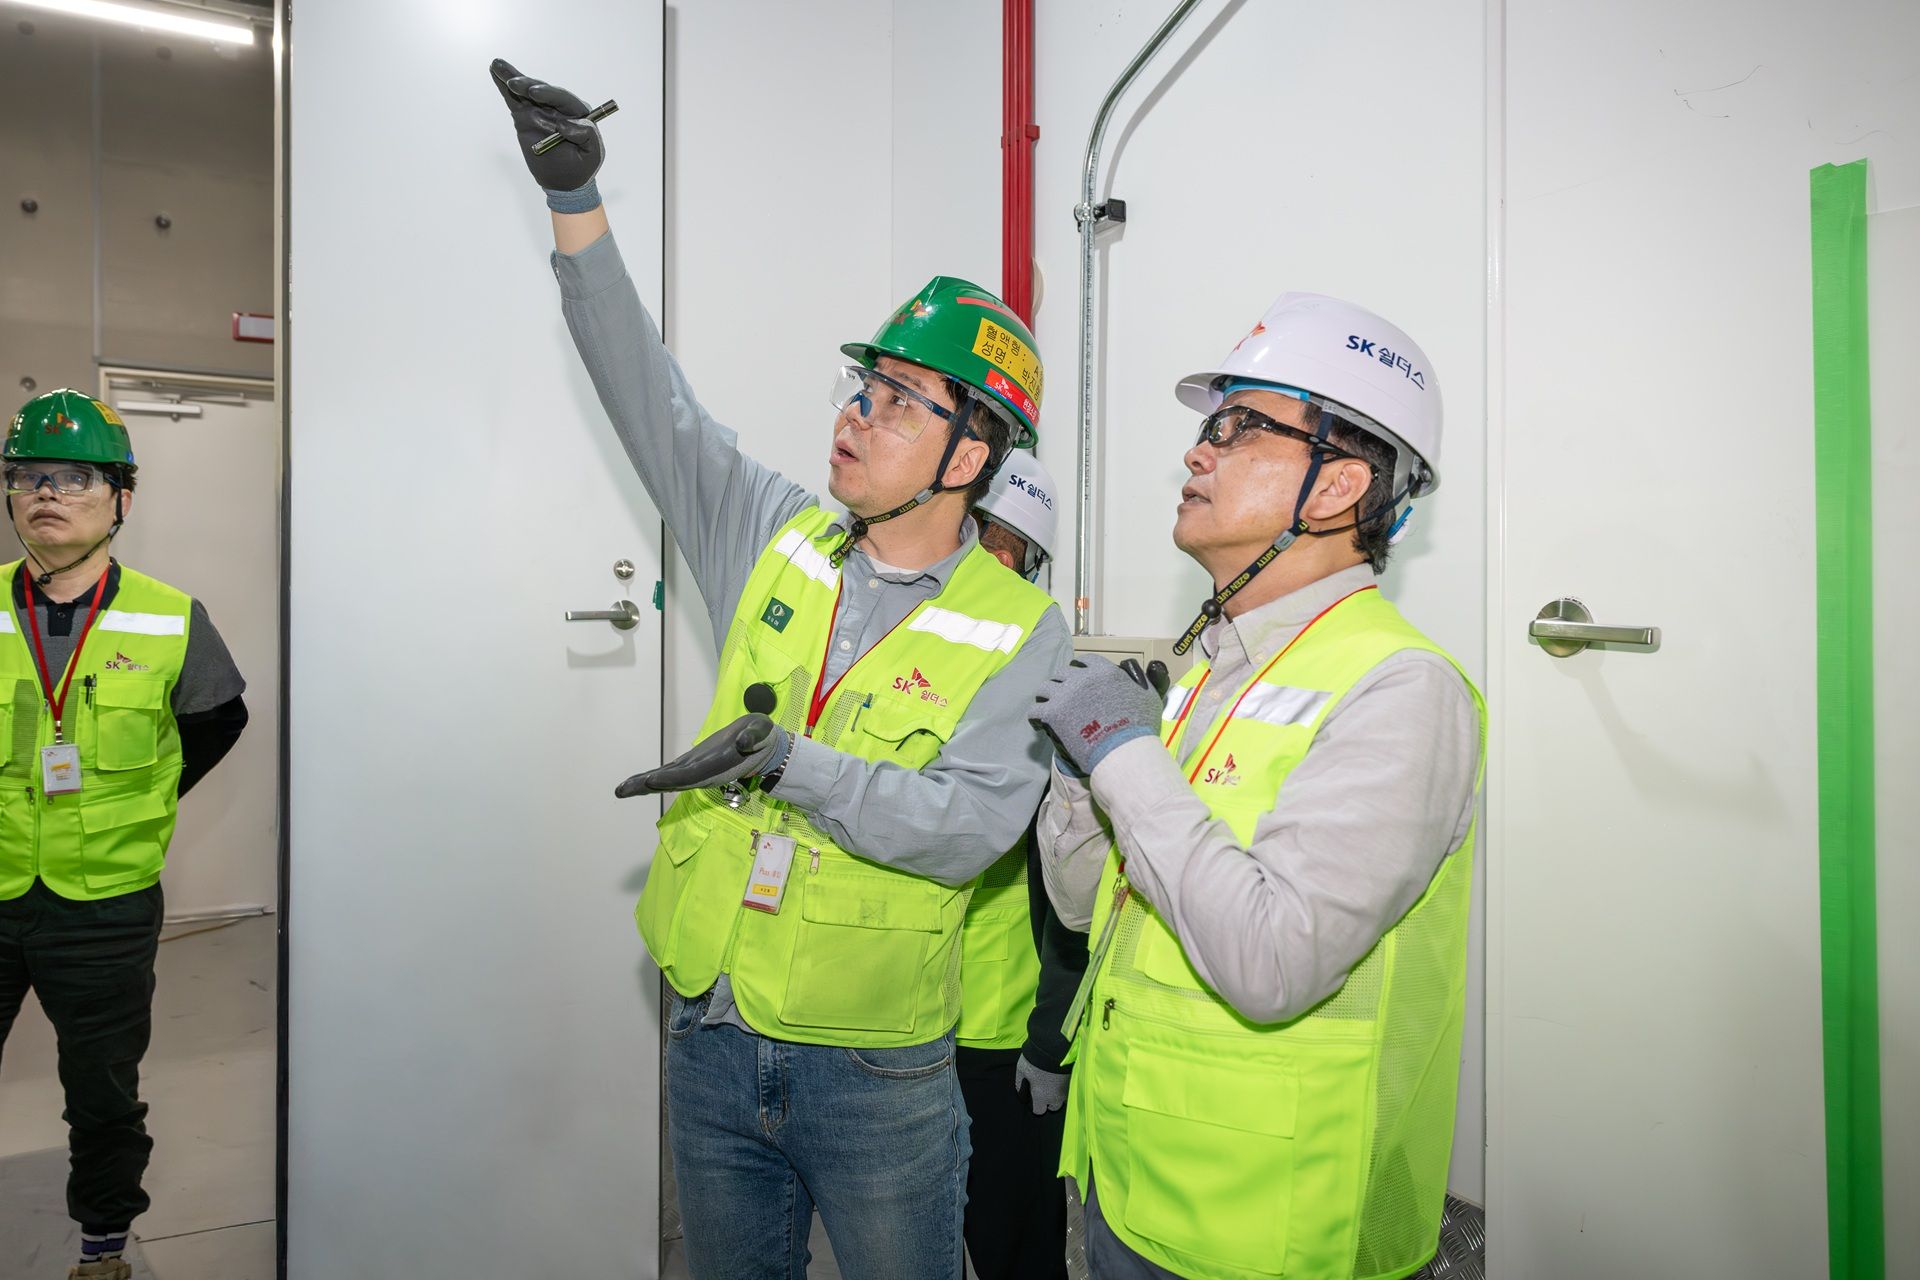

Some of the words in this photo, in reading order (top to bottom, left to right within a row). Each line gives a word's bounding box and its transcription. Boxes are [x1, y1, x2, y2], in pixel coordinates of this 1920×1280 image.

[1346, 334, 1376, 357] SK
[1378, 347, 1425, 391] 쉴더스
[1009, 474, 1026, 491] SK
[1027, 483, 1052, 511] 쉴더스
[1256, 549, 1276, 568] SAFETY
[105, 660, 120, 670] SK
[892, 676, 914, 695] SK
[920, 689, 948, 707] 쉴더스
[1080, 719, 1101, 739] 3M
[1204, 767, 1224, 784] SK
